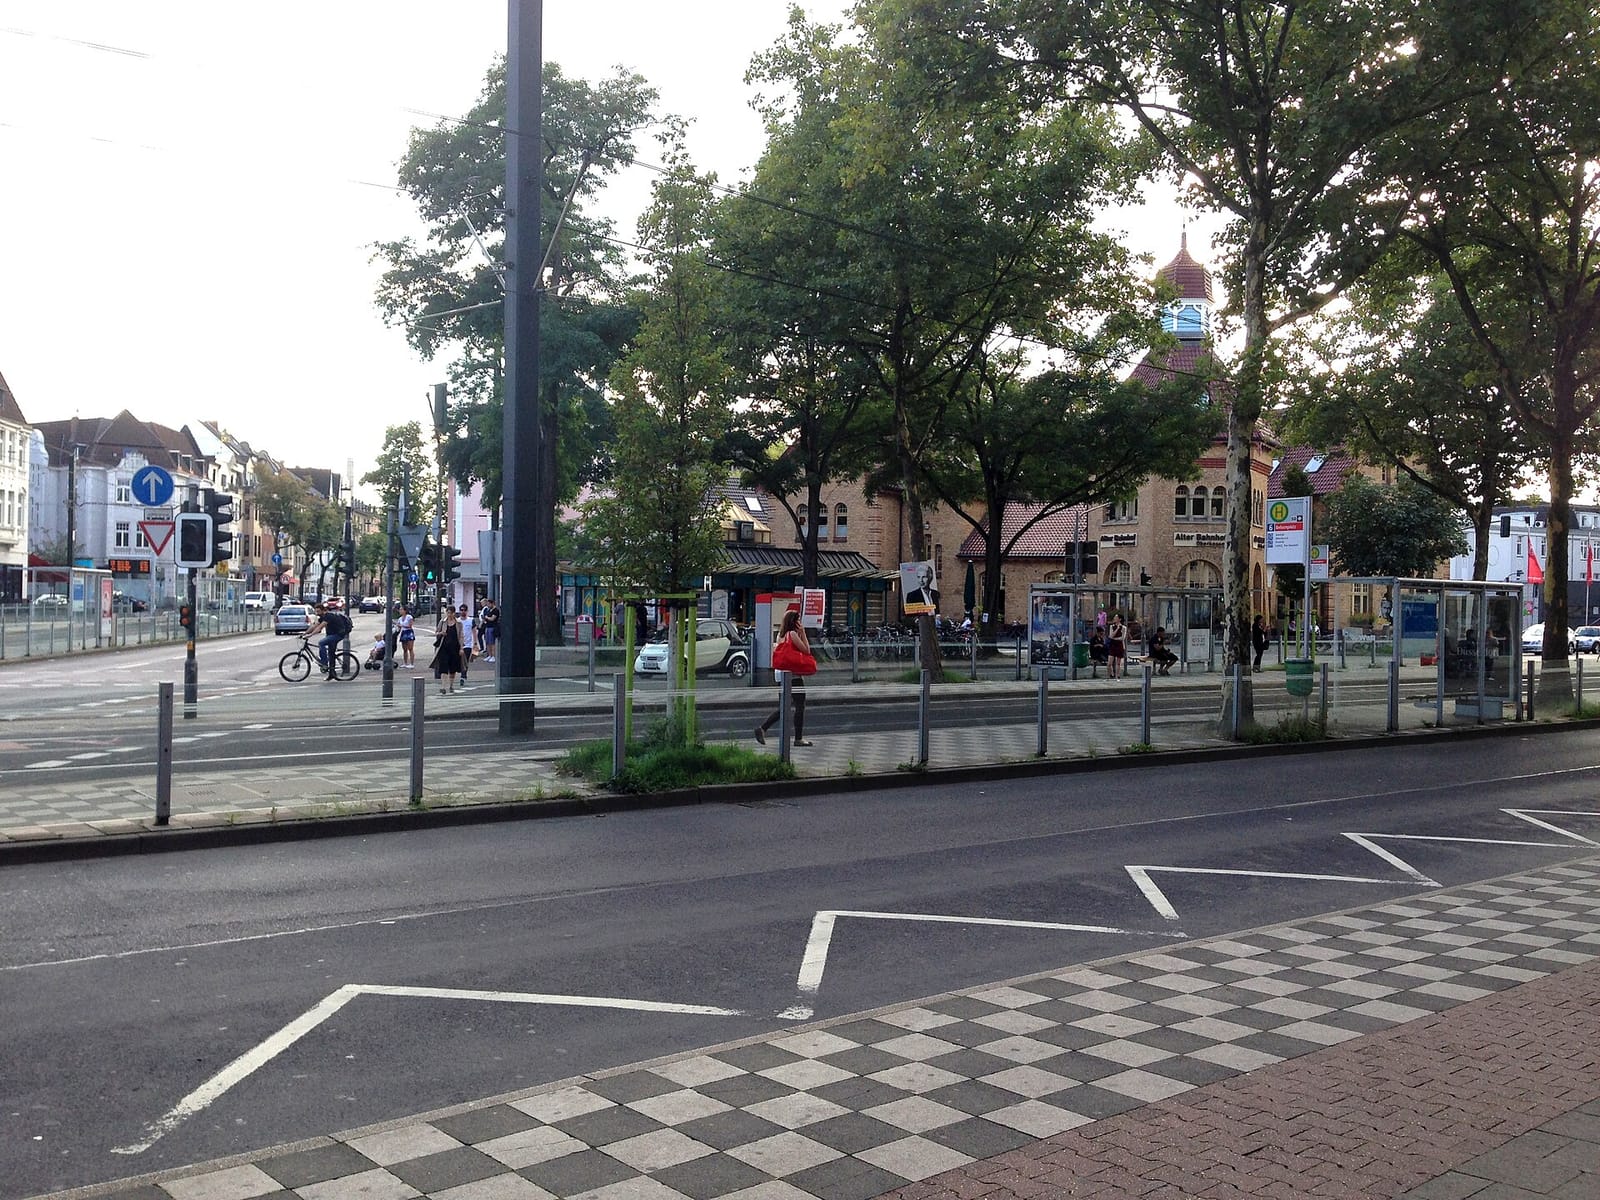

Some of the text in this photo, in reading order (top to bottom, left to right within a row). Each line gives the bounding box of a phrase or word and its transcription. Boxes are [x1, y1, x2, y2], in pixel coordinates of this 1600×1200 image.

[1275, 505, 1284, 519] H
[1175, 533, 1226, 541] Alter Bahnho
